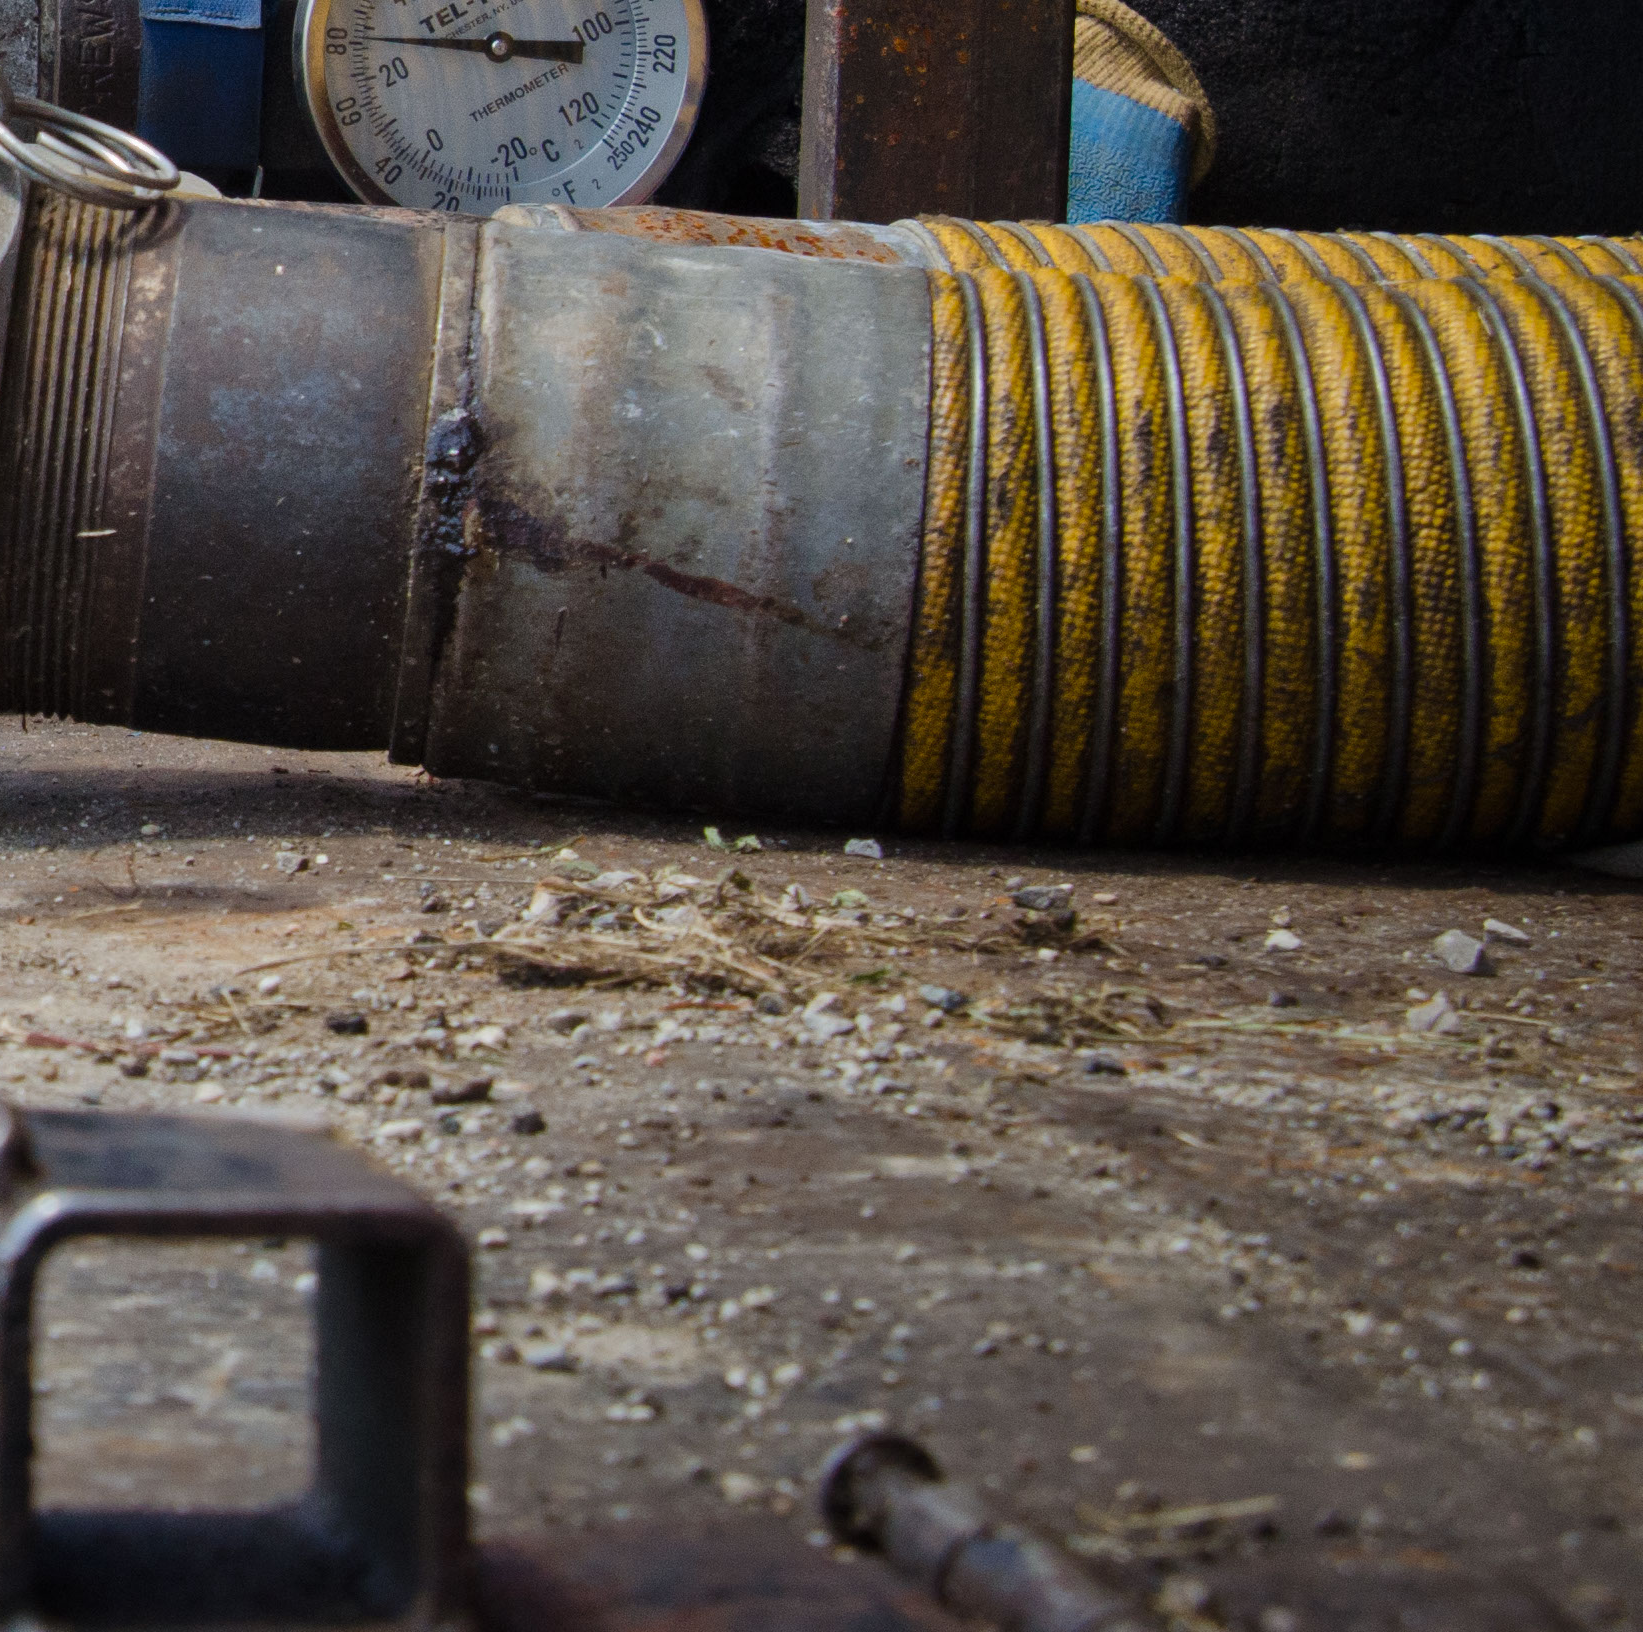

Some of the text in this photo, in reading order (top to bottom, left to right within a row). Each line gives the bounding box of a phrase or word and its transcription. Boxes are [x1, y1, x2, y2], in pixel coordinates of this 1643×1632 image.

[326, 27, 348, 56] 80
[571, 10, 613, 43] 100
[652, 34, 677, 74] 220
[379, 56, 410, 88] 20
[468, 62, 569, 124] THERMOMETER
[335, 97, 362, 127] 60
[557, 91, 601, 128] 120
[425, 127, 444, 152] 0
[628, 106, 662, 149] 240
[490, 136, 528, 170] -20
[607, 140, 635, 171] 250
[375, 155, 403, 186] 40
[434, 191, 461, 212] 20
